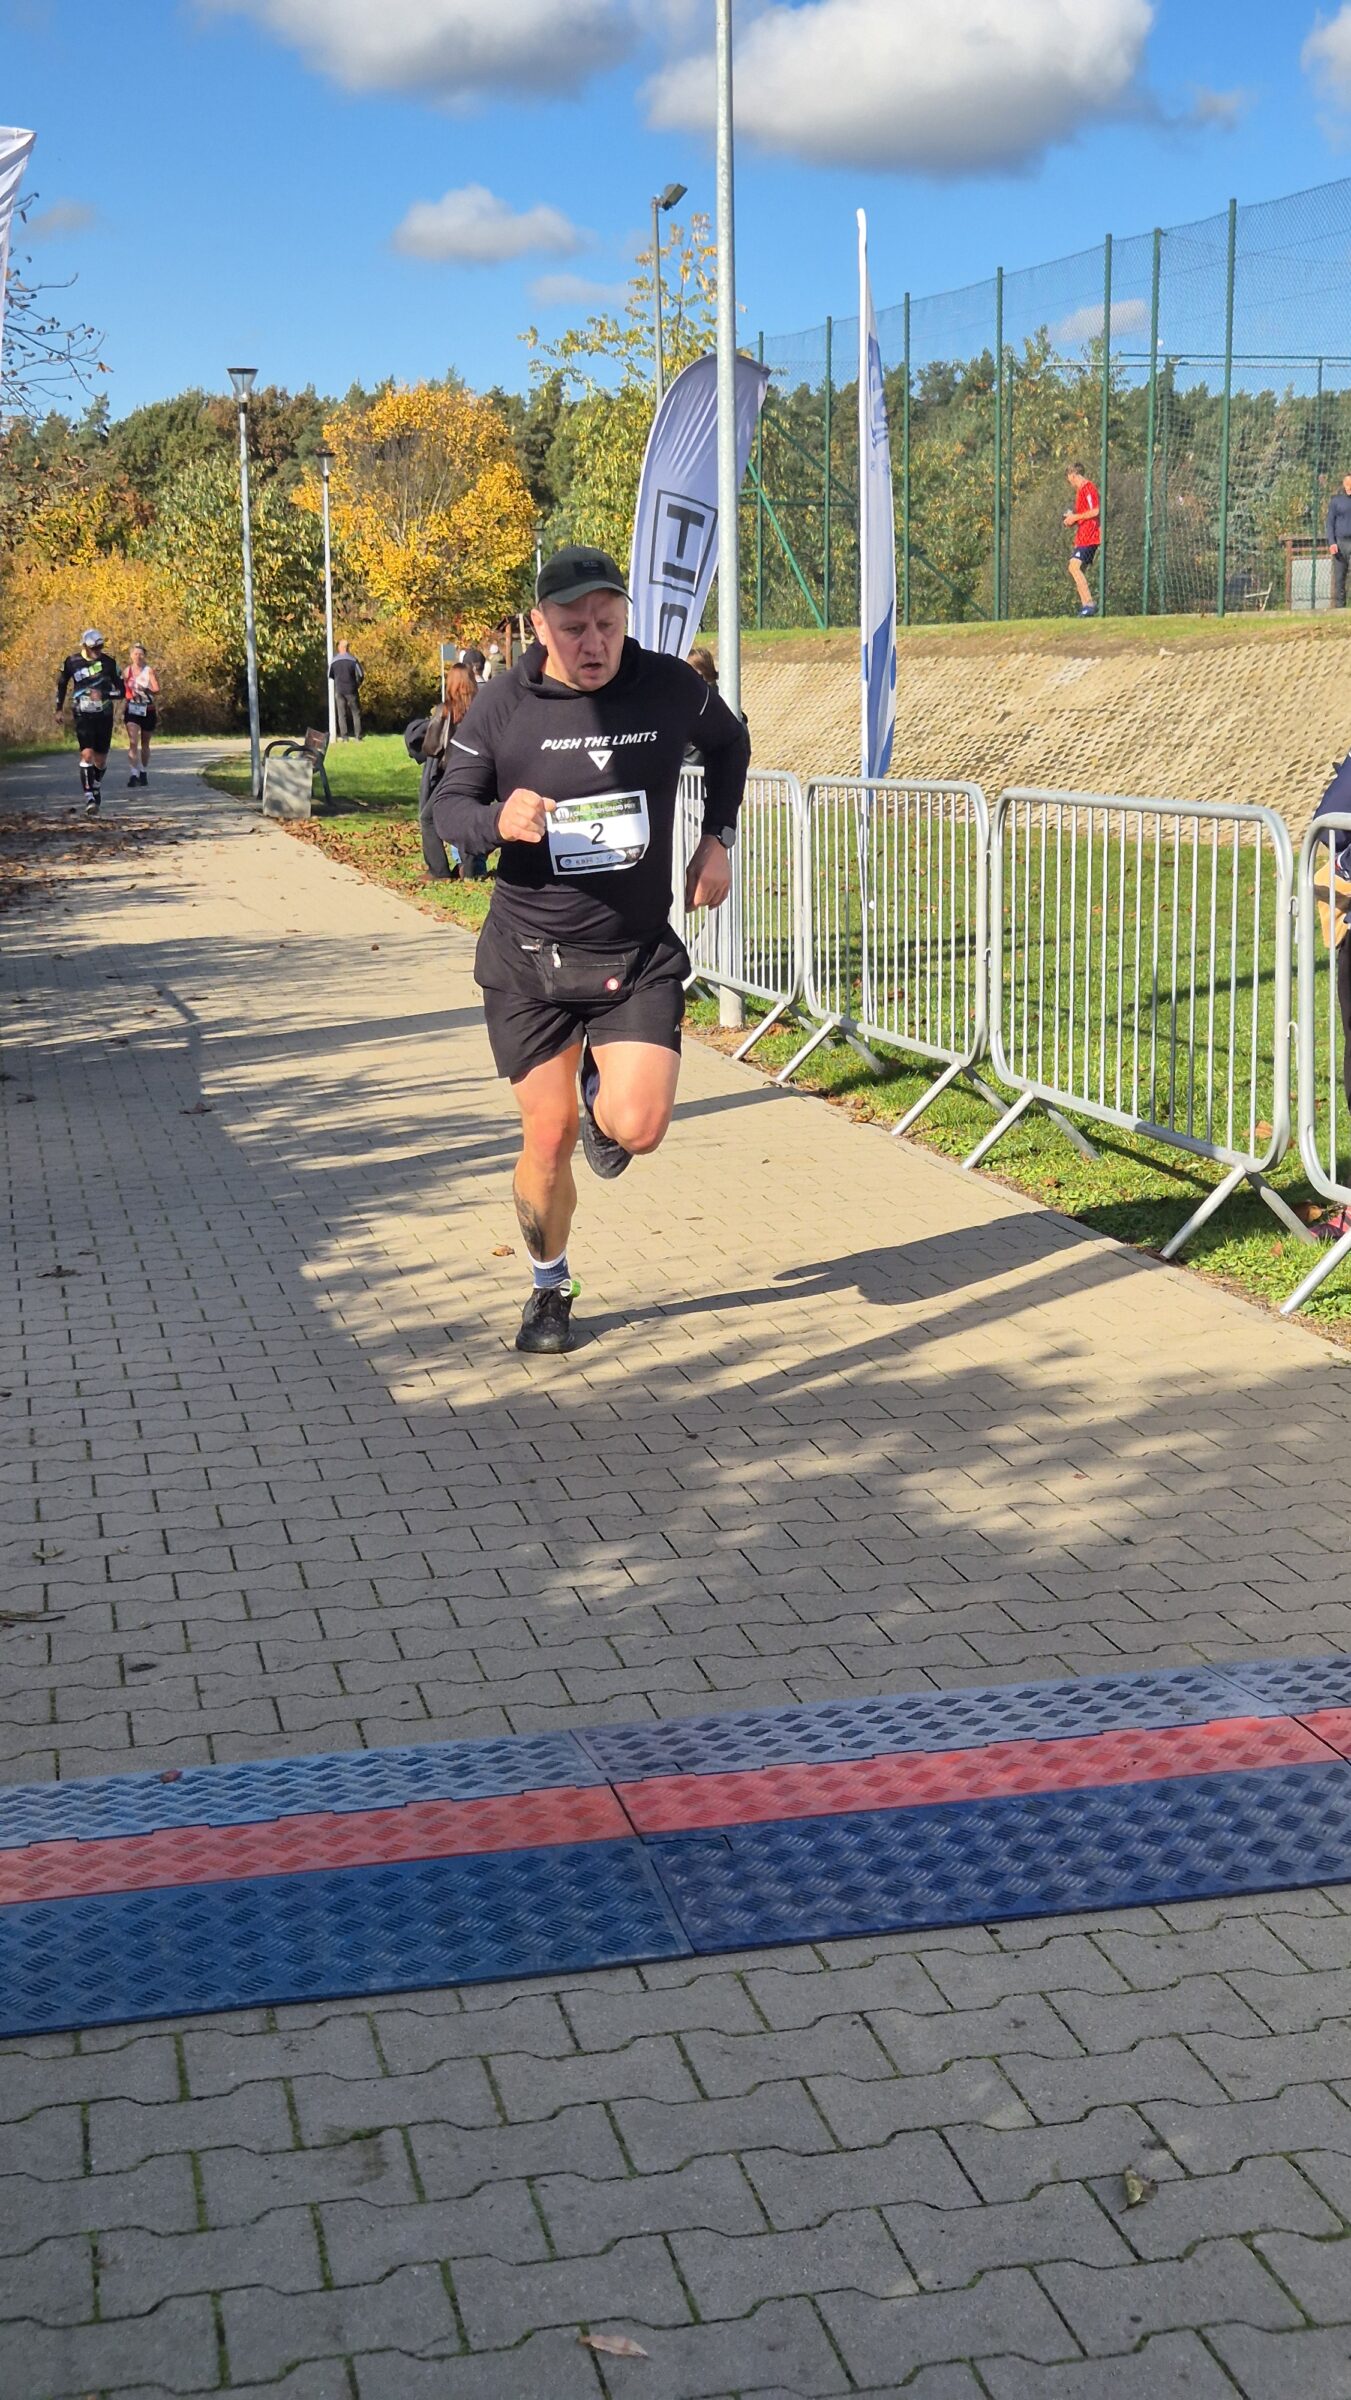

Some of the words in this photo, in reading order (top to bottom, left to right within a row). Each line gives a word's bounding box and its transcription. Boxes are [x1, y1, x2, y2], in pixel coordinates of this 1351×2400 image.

[541, 738, 582, 750] PUSH
[583, 736, 611, 749] THE
[612, 731, 658, 746] LIMITS
[590, 822, 606, 846] 2
